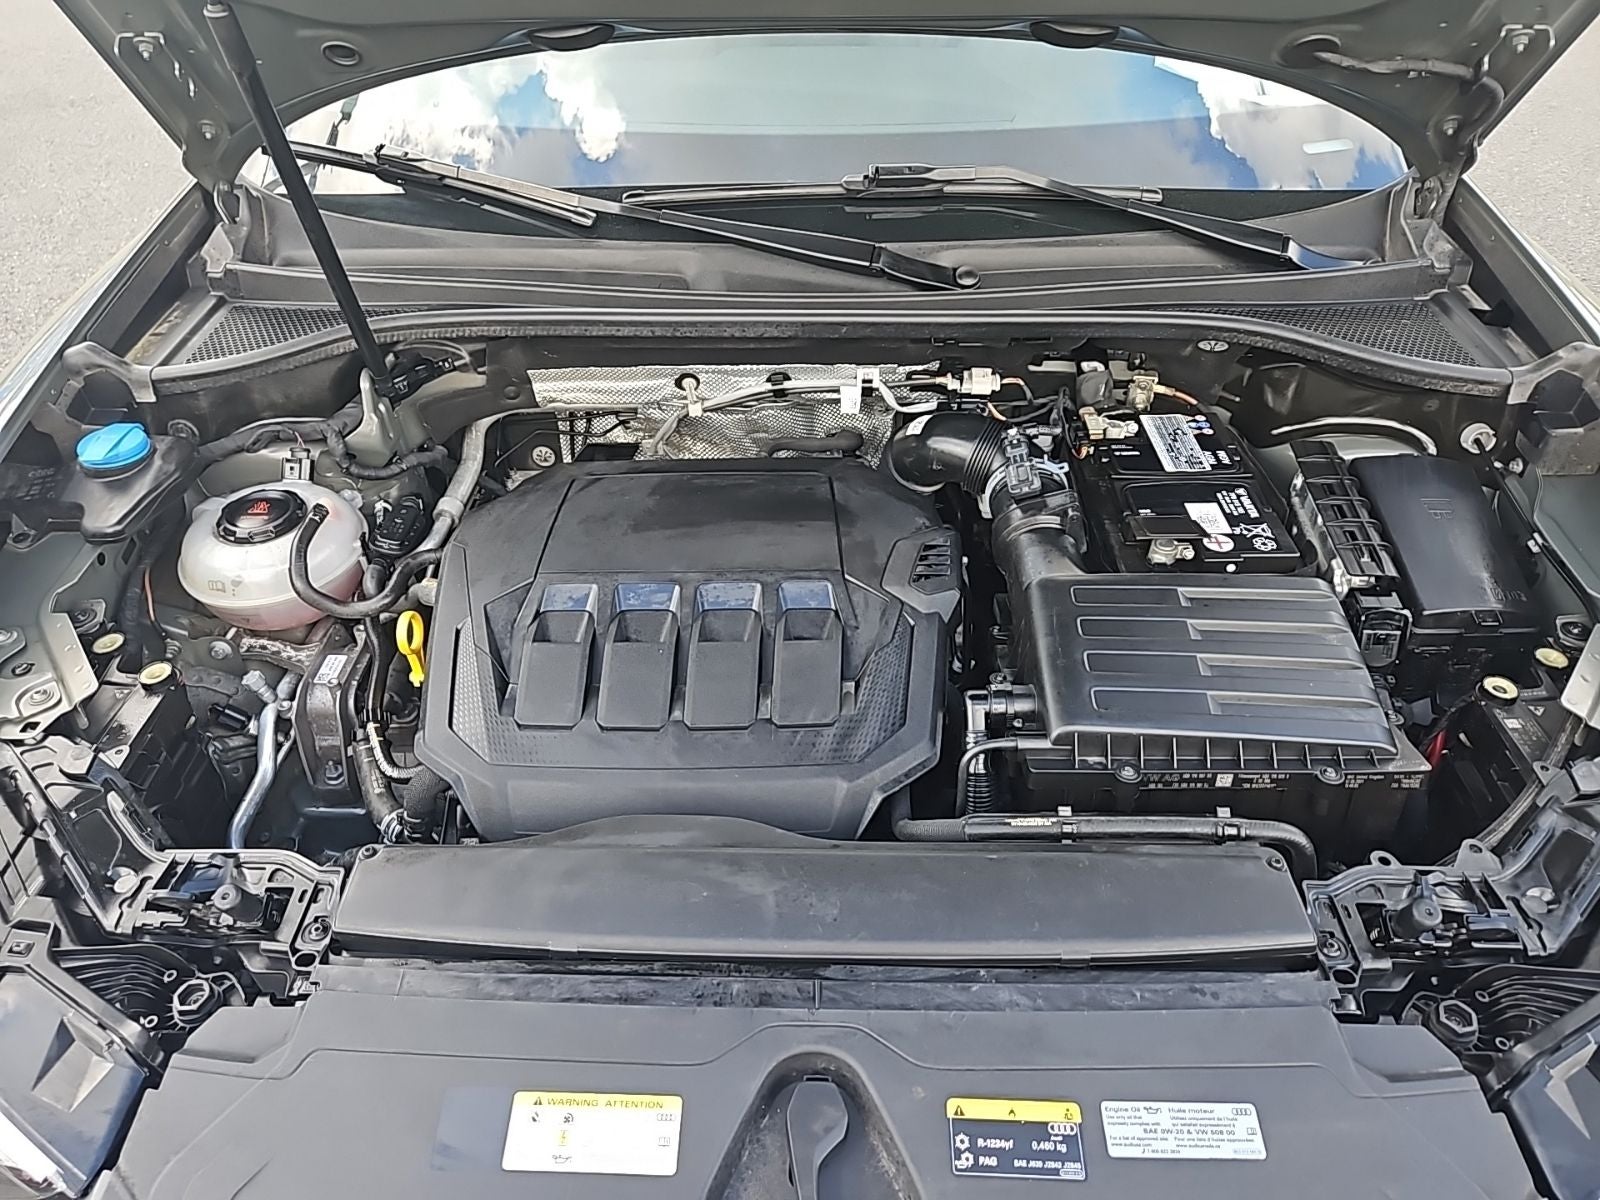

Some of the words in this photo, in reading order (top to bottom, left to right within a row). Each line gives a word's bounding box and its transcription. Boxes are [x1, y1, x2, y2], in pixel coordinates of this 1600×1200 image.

[547, 1097, 599, 1107] WARNING
[604, 1099, 664, 1109] ATTENTION
[1104, 1106, 1129, 1114] Engine
[977, 1137, 1014, 1151] R-1234yf
[1056, 1141, 1067, 1154] kg
[978, 1155, 998, 1167] PAG
